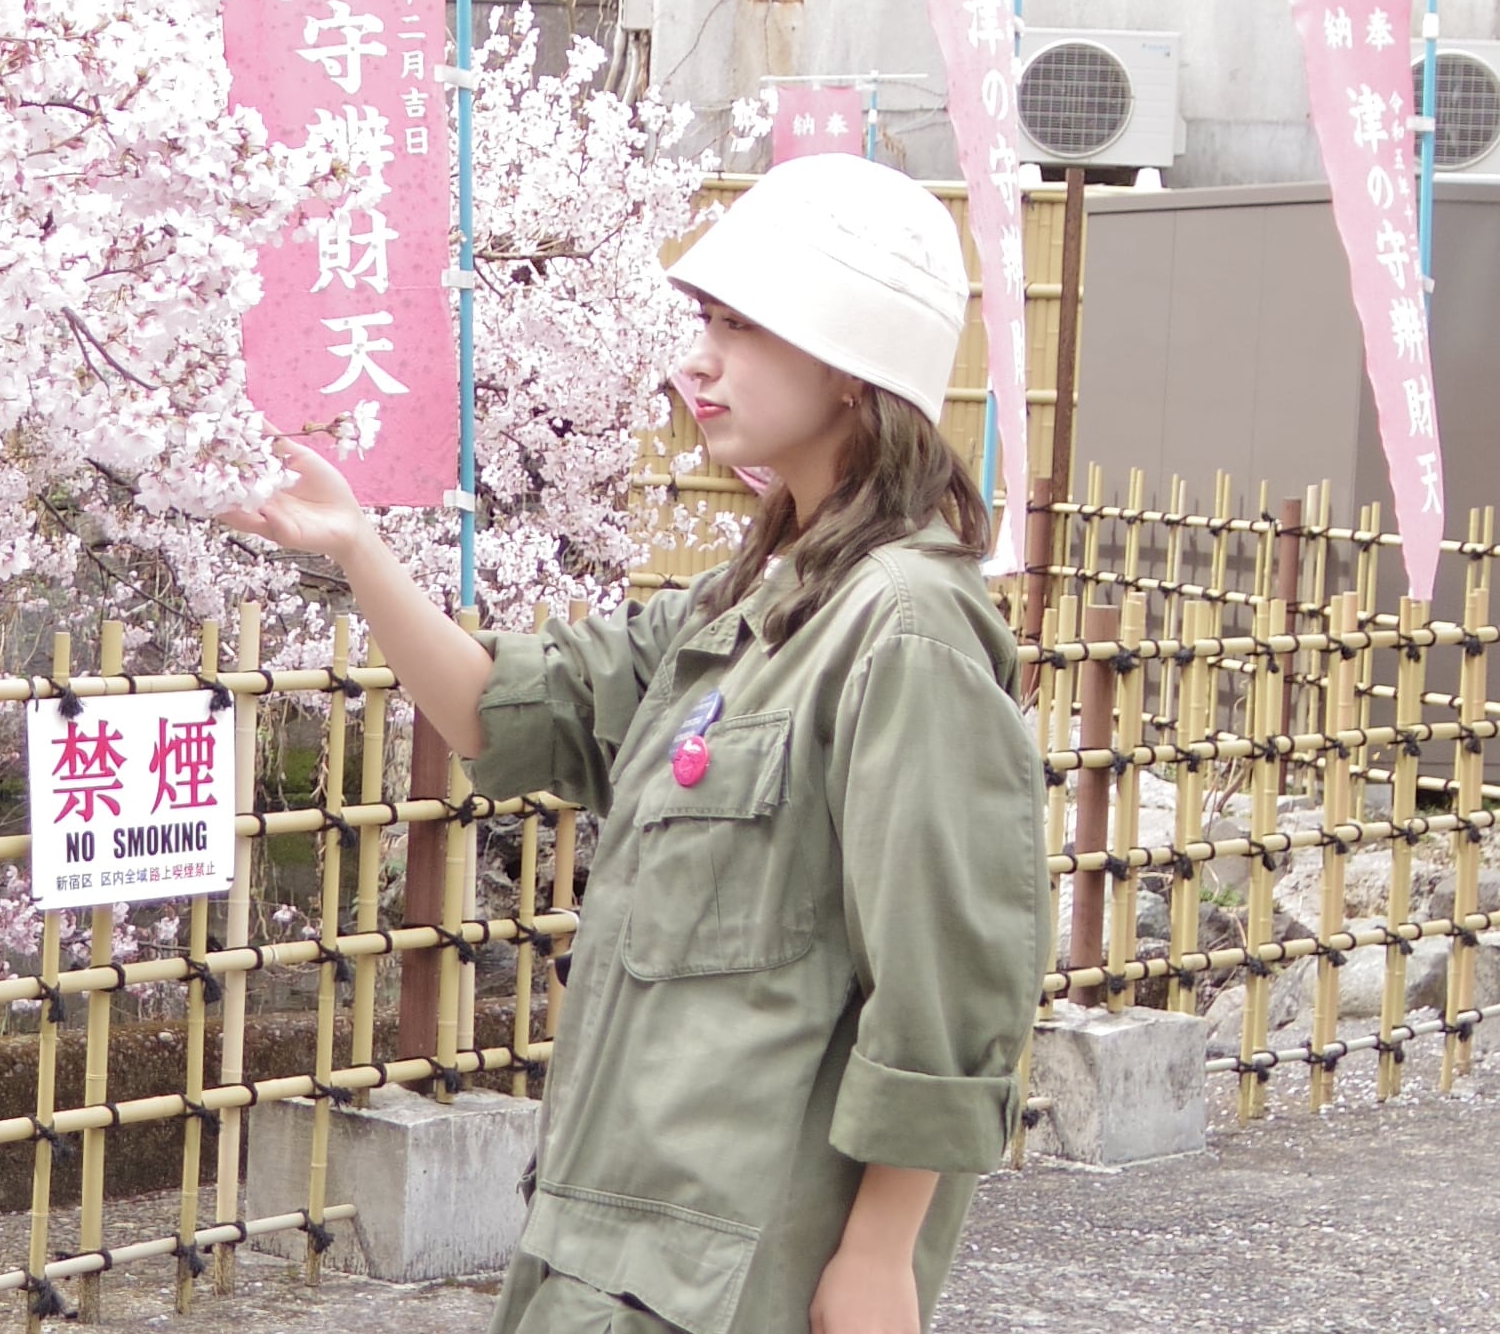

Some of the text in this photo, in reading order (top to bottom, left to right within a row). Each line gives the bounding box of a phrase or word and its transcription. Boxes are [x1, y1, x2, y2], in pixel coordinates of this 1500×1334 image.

[51, 715, 218, 825] 禁煙
[66, 820, 208, 863] NO SMOKING
[56, 872, 93, 891] 新宿区
